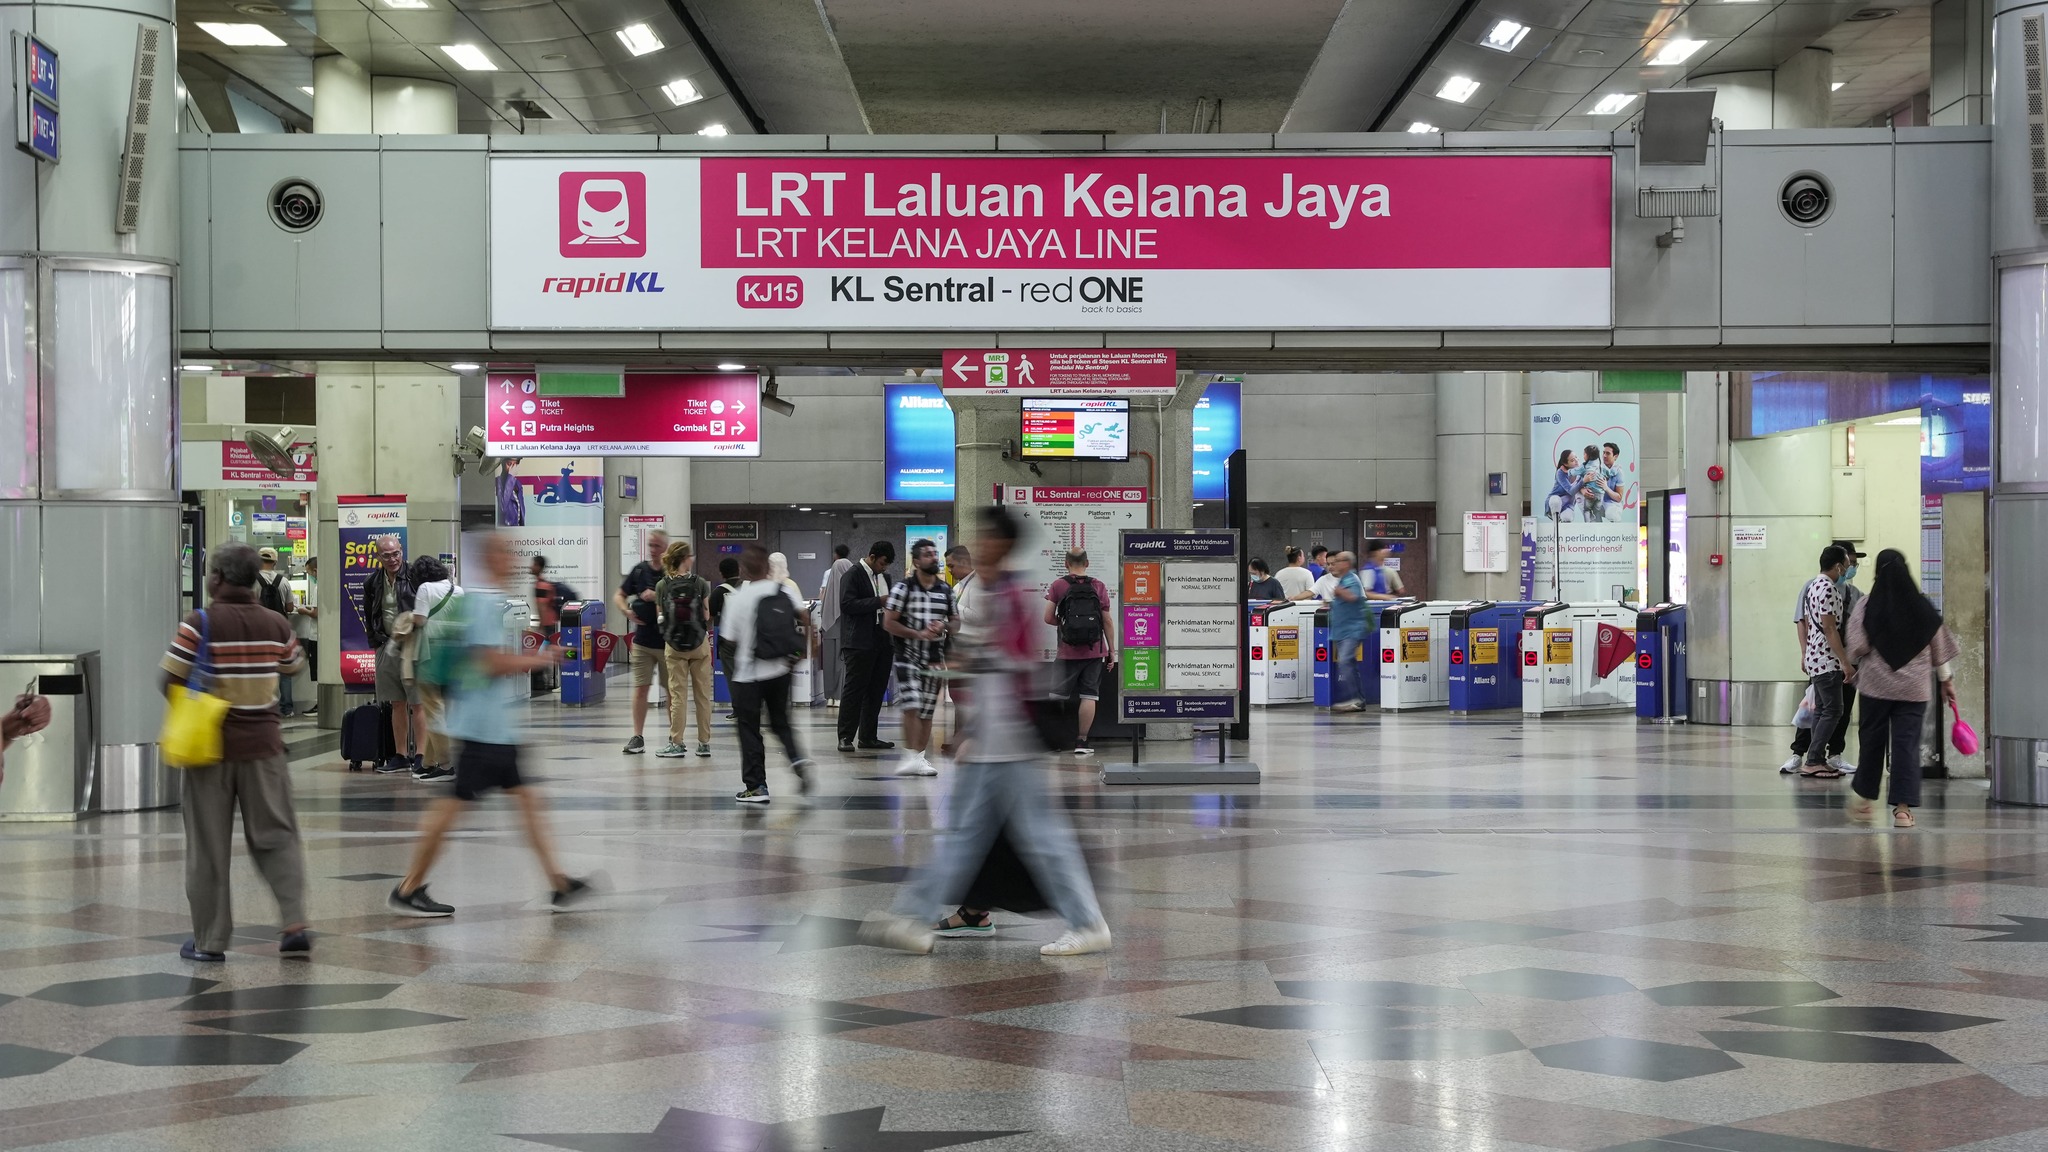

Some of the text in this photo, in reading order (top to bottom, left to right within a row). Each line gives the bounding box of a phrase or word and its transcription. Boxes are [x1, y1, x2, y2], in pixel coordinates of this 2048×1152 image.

[37, 56, 47, 83] LRT
[37, 115, 49, 140] TIKET
[736, 172, 1391, 230] LRT Laluan Kelana Jaya
[736, 228, 1158, 259] LRT KELANA JAYA LINE
[542, 271, 665, 298] rapidKL
[743, 282, 799, 302] KJ15
[830, 276, 875, 302] KL
[883, 276, 994, 303] Sentral
[1081, 305, 1143, 314] back to basics
[540, 399, 560, 408] Tiket
[687, 399, 707, 408] Tiket
[899, 395, 944, 409] Allianz
[540, 423, 595, 433] Putra Heights
[673, 423, 708, 432] Gombak
[564, 444, 581, 452] Jaya
[713, 443, 746, 452] rapidKL
[1035, 491, 1048, 499] KL
[1049, 490, 1080, 499] Sentral
[367, 511, 400, 520] rapidKL
[514, 537, 555, 546] motosikal
[557, 537, 575, 546] dan
[576, 537, 588, 546] diri
[1565, 534, 1621, 543] perlindungan
[1129, 541, 1167, 550] rapidKL
[1567, 545, 1623, 554] komprehensif
[1273, 672, 1291, 680] Allianz
[1473, 676, 1490, 684] Allianz
[1549, 677, 1565, 685] Allianz
